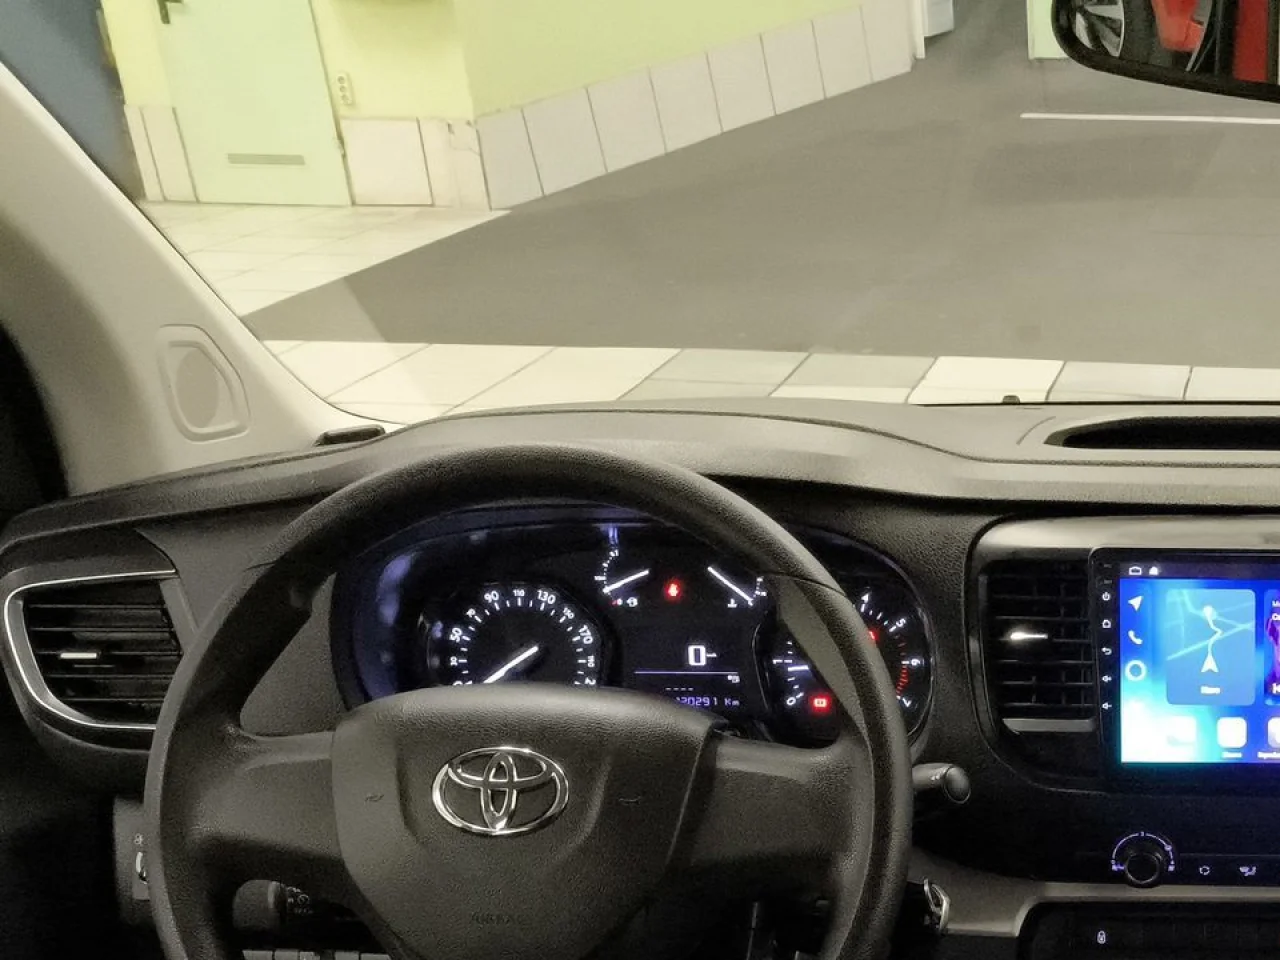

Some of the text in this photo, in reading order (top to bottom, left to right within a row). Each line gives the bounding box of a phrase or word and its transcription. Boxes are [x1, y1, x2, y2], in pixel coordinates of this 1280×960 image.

[483, 590, 500, 604] 90
[537, 590, 557, 605] 130
[449, 627, 463, 643] 50
[578, 624, 593, 645] 170
[687, 644, 707, 666] 0
[786, 697, 796, 707] 0
